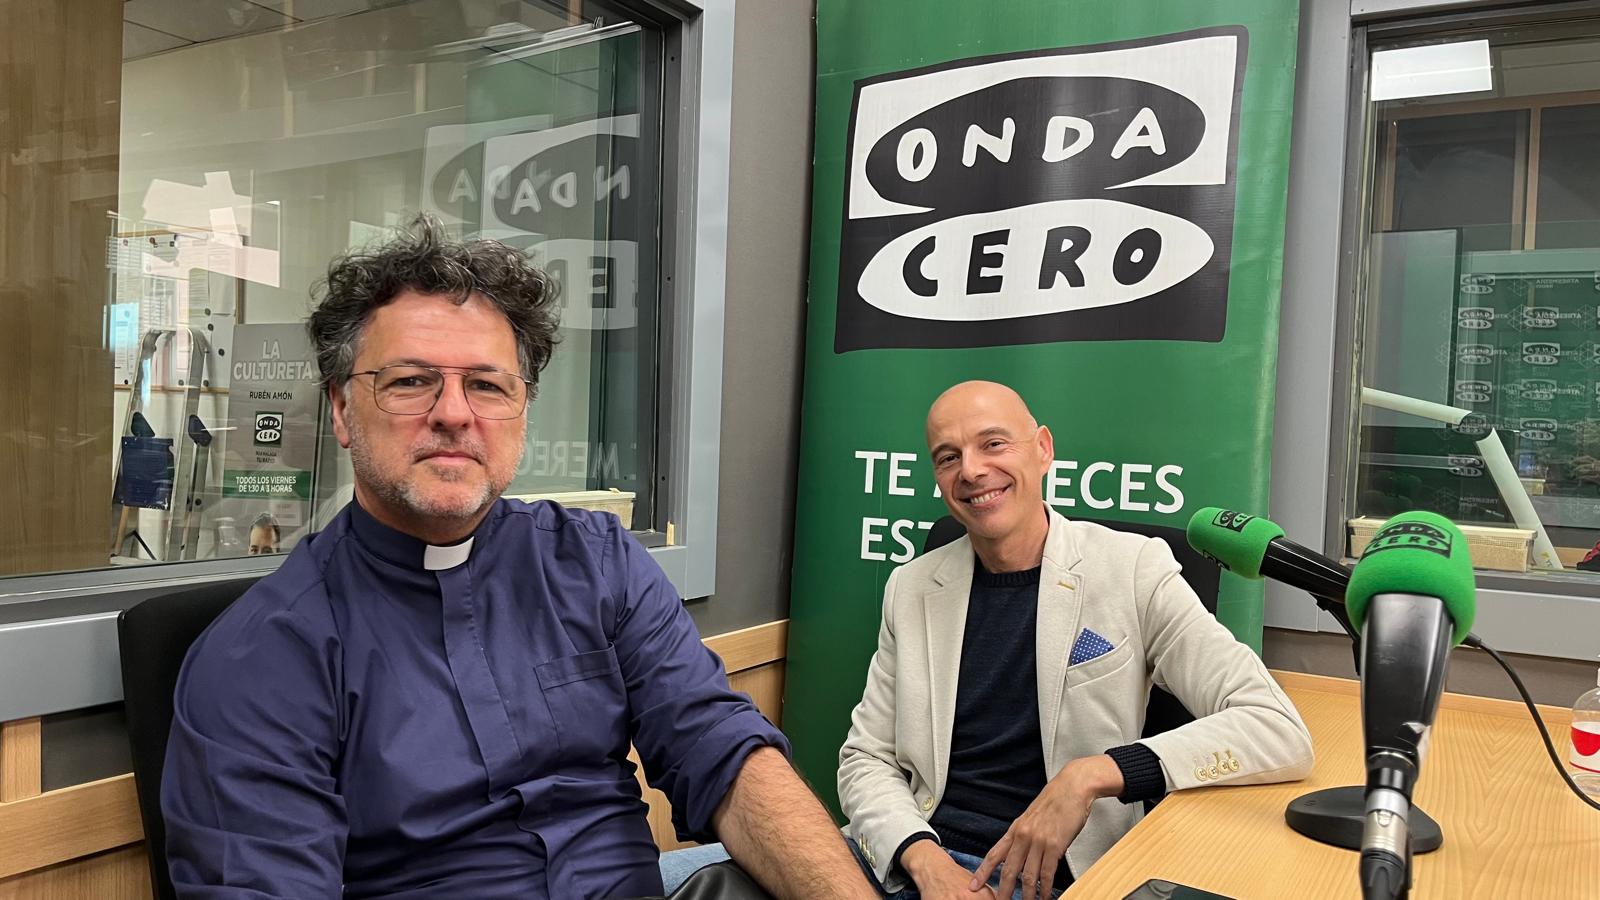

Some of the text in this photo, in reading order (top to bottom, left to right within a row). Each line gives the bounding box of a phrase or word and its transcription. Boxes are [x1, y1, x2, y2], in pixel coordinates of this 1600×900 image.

[896, 107, 1166, 182] ONDA
[902, 225, 1162, 297] CERO
[262, 341, 281, 359] LA
[233, 361, 313, 381] CULTURETA
[249, 389, 293, 400] RUBÉN AMÓN
[259, 420, 279, 428] ONDA
[260, 432, 278, 440] CERO
[236, 476, 297, 485] TODOS LOS VIERNES
[855, 451, 917, 497] TE
[239, 485, 247, 493] DE
[260, 485, 265, 493] A
[266, 485, 270, 493] 3
[270, 485, 293, 493] HORAS
[860, 517, 934, 563] ES
